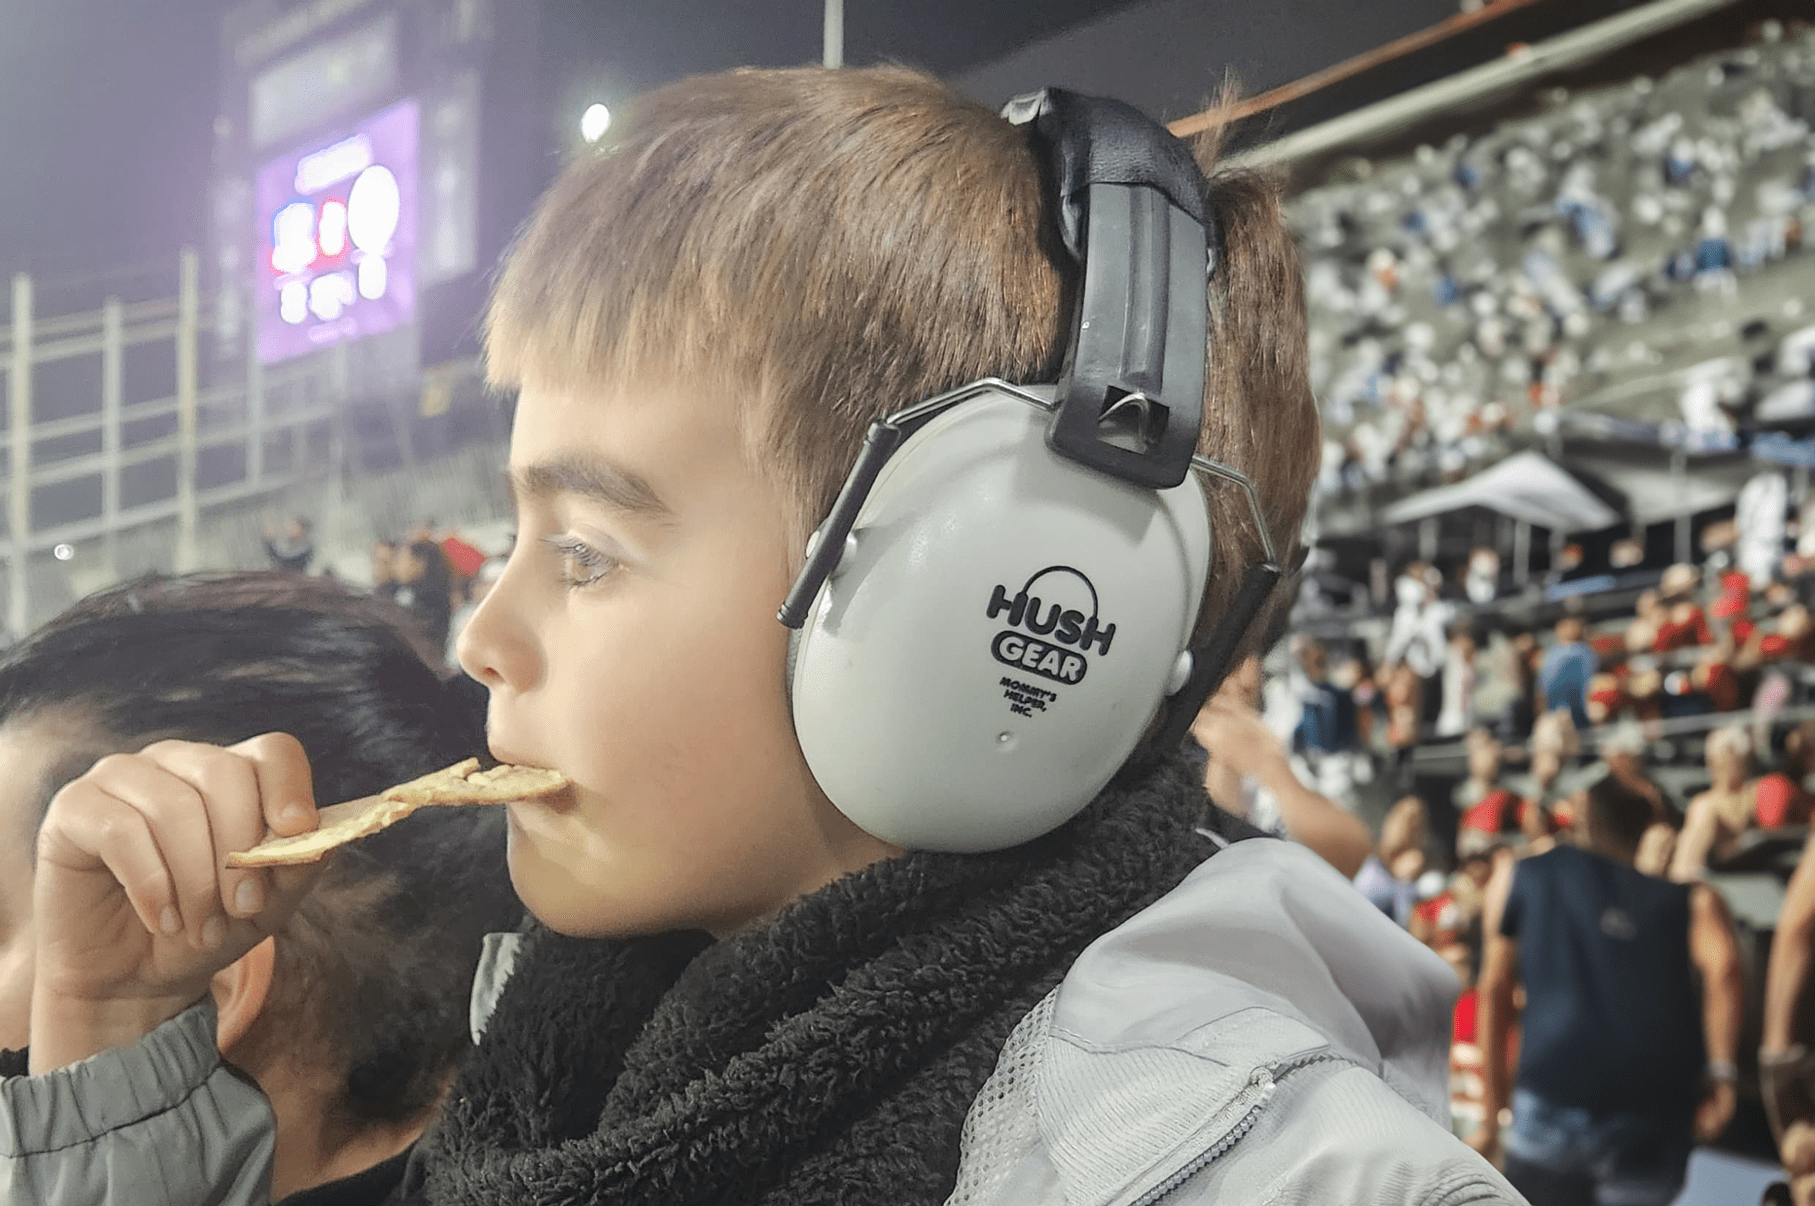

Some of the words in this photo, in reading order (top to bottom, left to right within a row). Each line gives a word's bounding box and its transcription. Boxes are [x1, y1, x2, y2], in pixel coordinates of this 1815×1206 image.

[986, 584, 1116, 656] HUSH
[998, 636, 1081, 681] GEAR
[999, 676, 1057, 702] MOMMY'S
[1010, 703, 1032, 718] INC.
